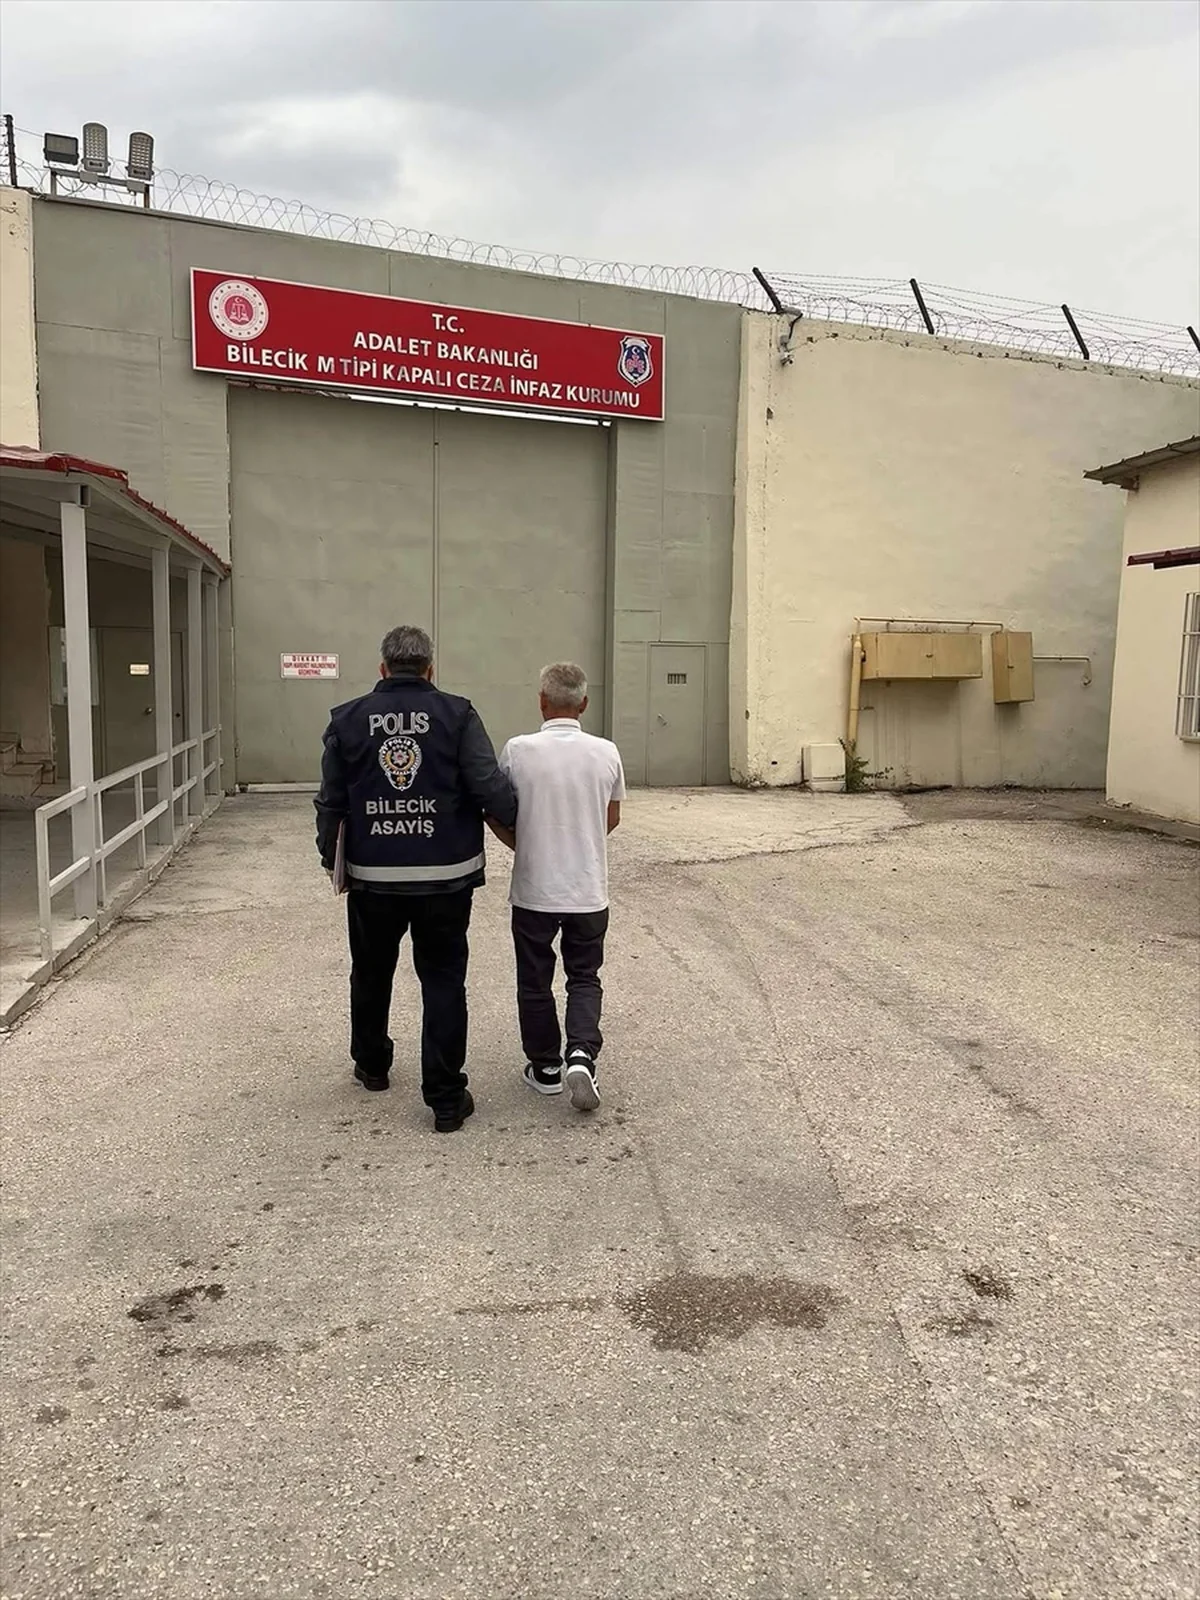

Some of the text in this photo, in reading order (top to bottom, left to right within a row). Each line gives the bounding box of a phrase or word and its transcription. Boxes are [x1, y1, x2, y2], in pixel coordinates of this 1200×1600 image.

[432, 313, 465, 333] T.C.
[353, 331, 538, 370] ADALET BAKANLIĞI
[226, 341, 641, 408] BİLECİK M TİPİ KAPALI CEZA İNFAZ KURUMU
[365, 795, 437, 815] BİLECİK
[370, 816, 435, 838] ASAYİŞ
